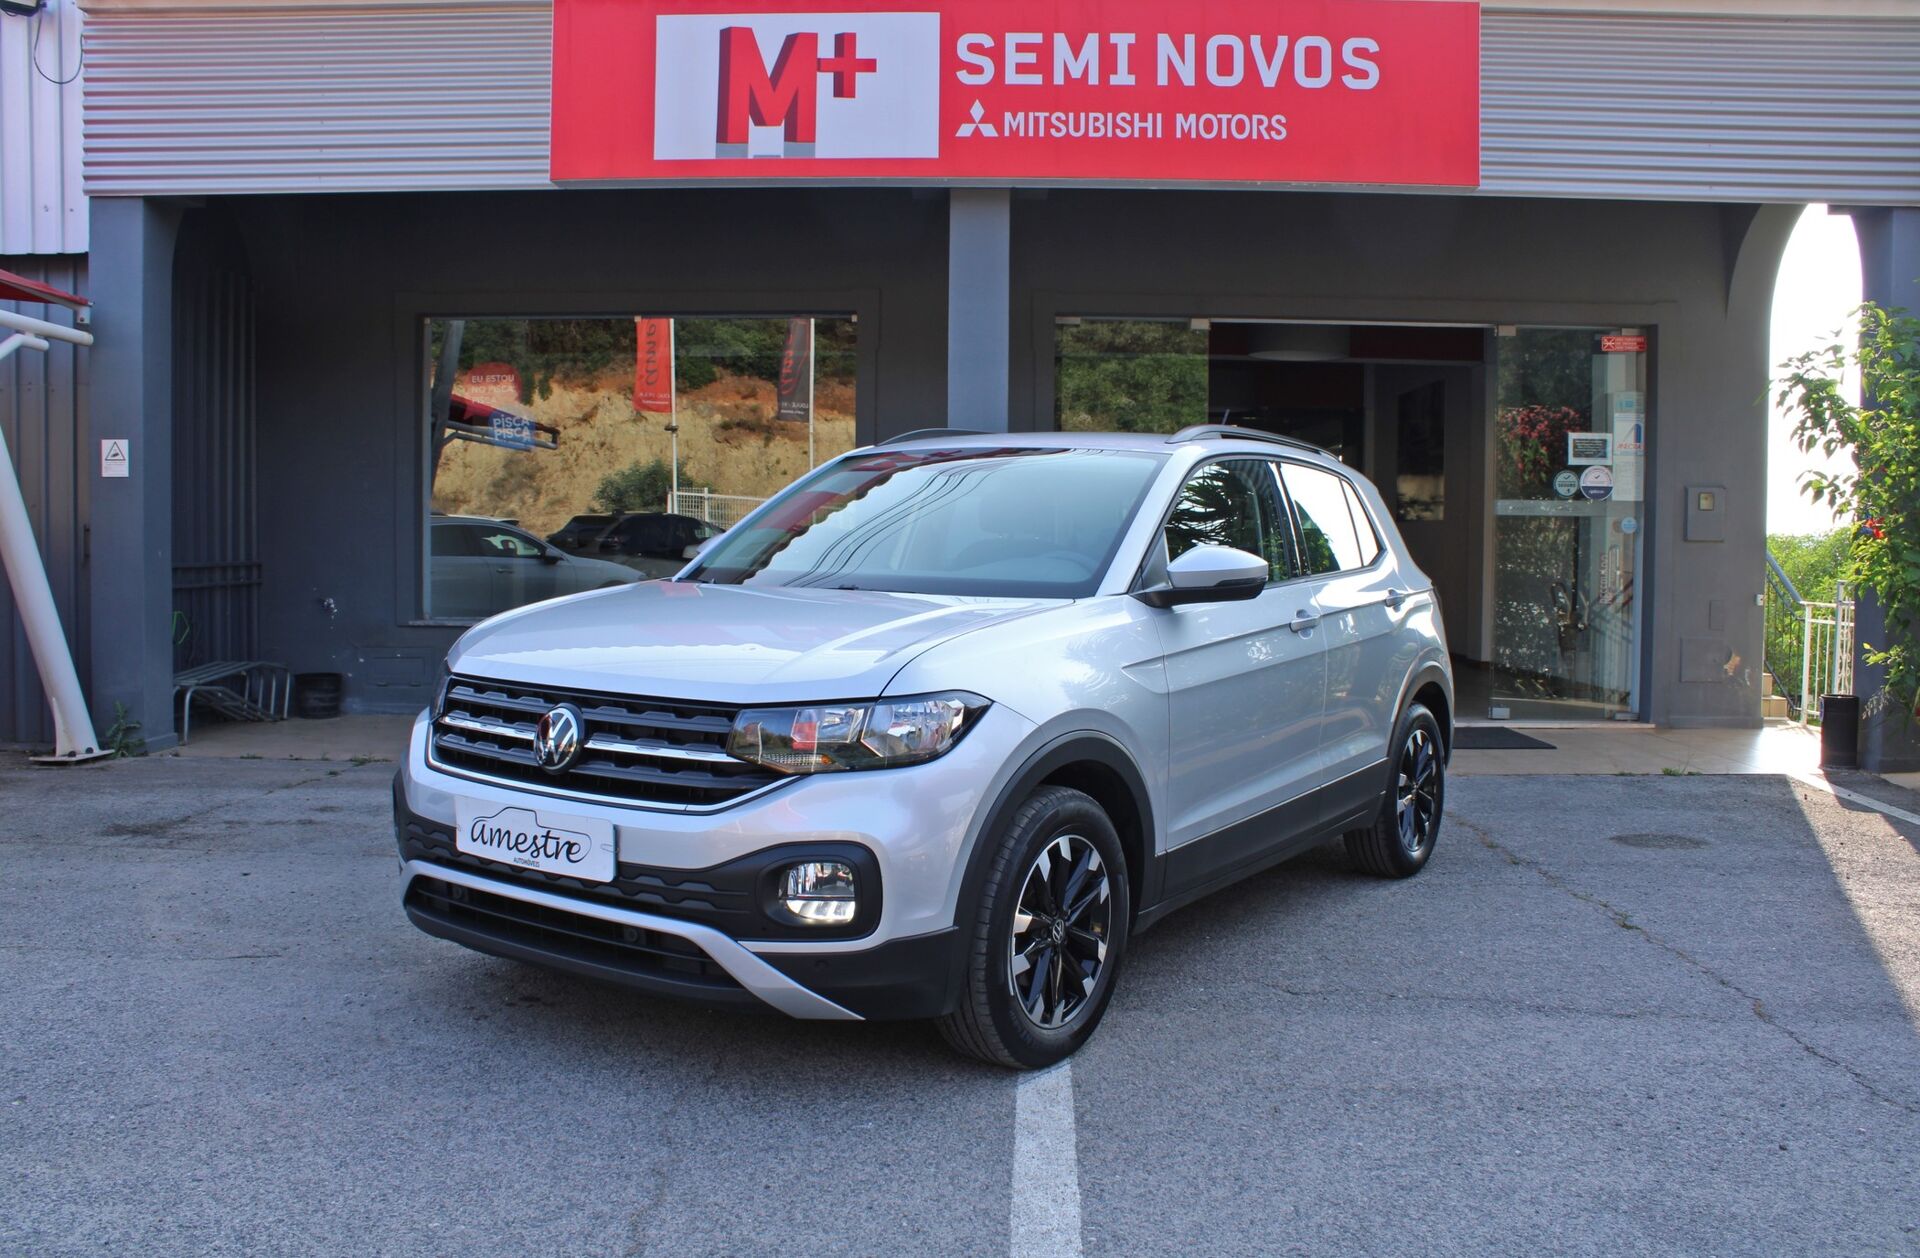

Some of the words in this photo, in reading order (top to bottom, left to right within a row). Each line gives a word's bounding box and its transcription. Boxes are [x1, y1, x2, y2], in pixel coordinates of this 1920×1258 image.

[955, 32, 1136, 86] SEMI
[1157, 33, 1381, 90] NOVOS
[1004, 110, 1162, 138] MITSUBISHI
[1175, 112, 1288, 141] MOTORS
